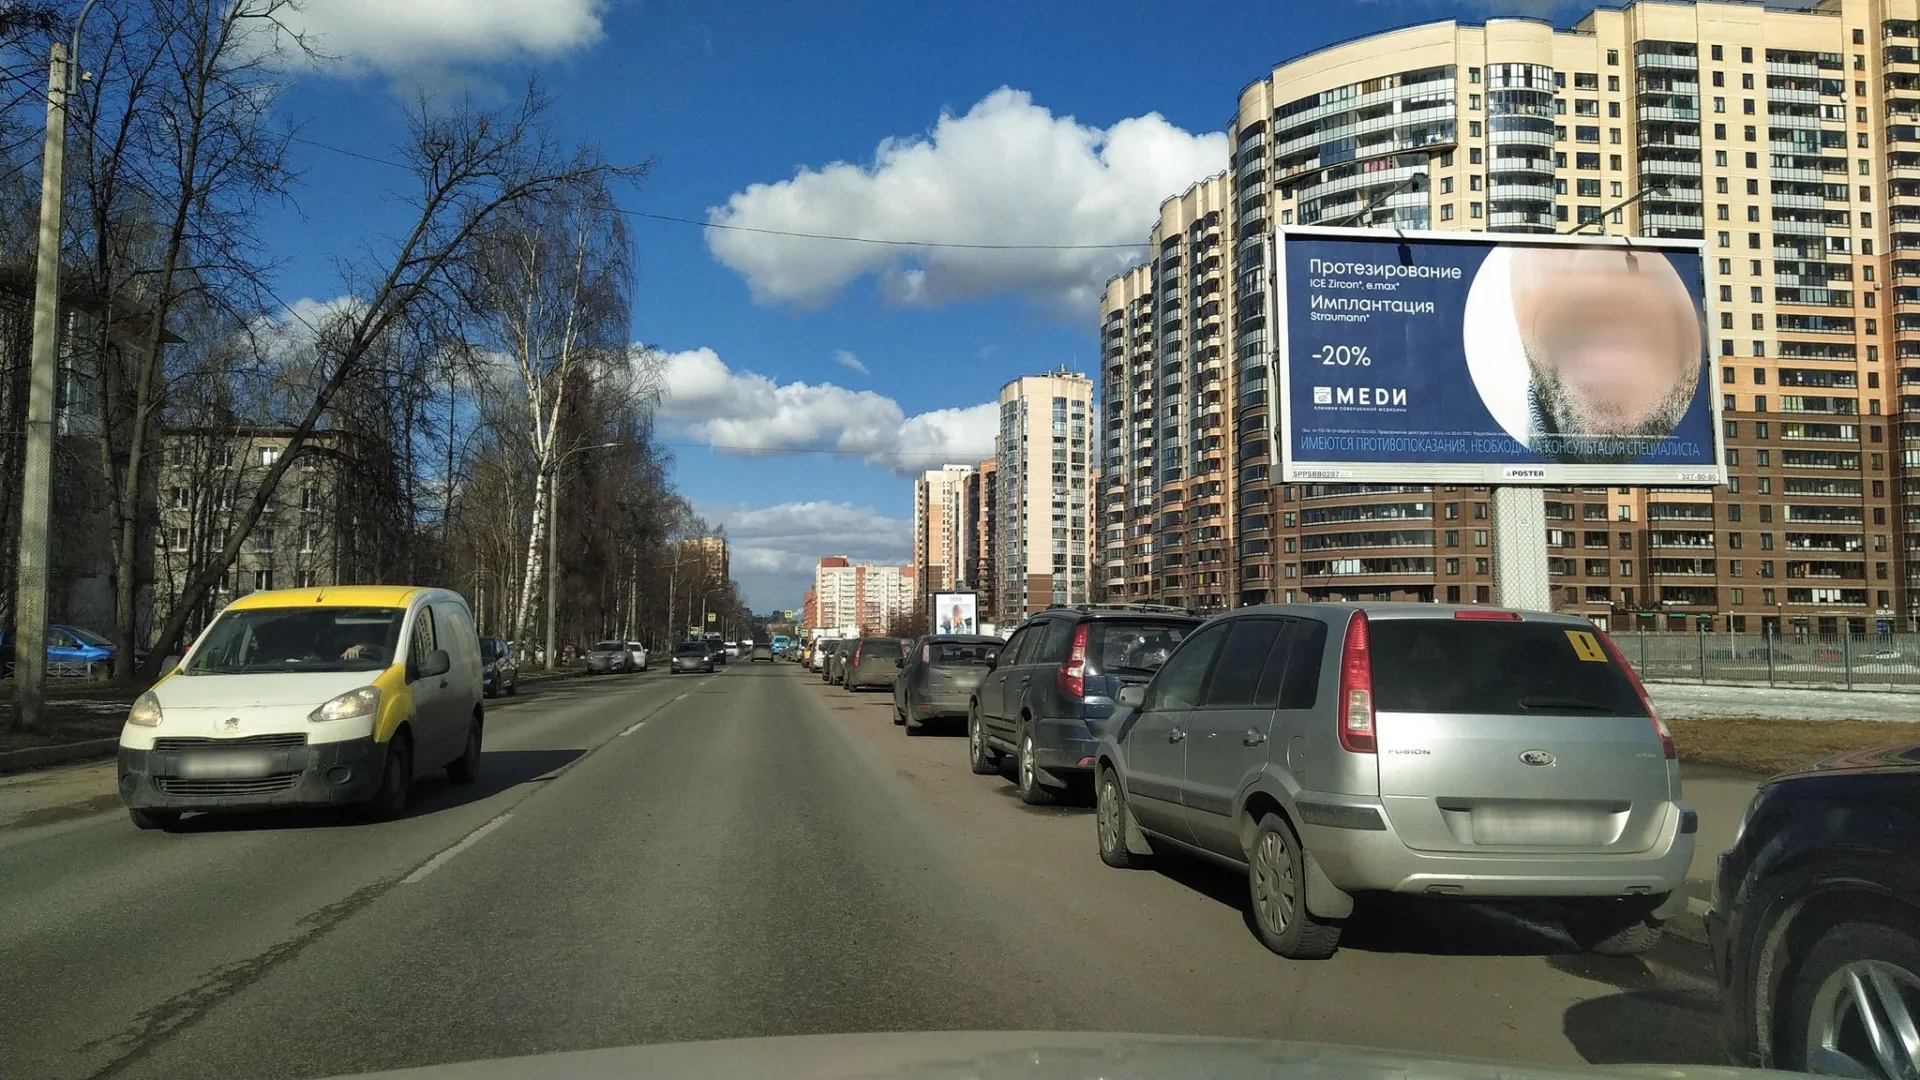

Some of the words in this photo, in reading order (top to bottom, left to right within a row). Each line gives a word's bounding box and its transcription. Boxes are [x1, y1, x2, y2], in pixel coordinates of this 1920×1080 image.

[1309, 258, 1462, 280] Протезирование
[1310, 278, 1327, 288] ICE
[1311, 294, 1435, 316] Имплантация
[1312, 345, 1372, 367] -20%
[1301, 436, 1354, 451] ИМЕЮТСЯ
[1356, 437, 1468, 455] ПРОТИВОПОКАЗАНИЯ,
[1544, 439, 1625, 457] КОНСУЛЬТАЦИЯ
[1627, 441, 1701, 458] СПЕЦИАЛИСТА
[1387, 748, 1432, 756] FUSION
